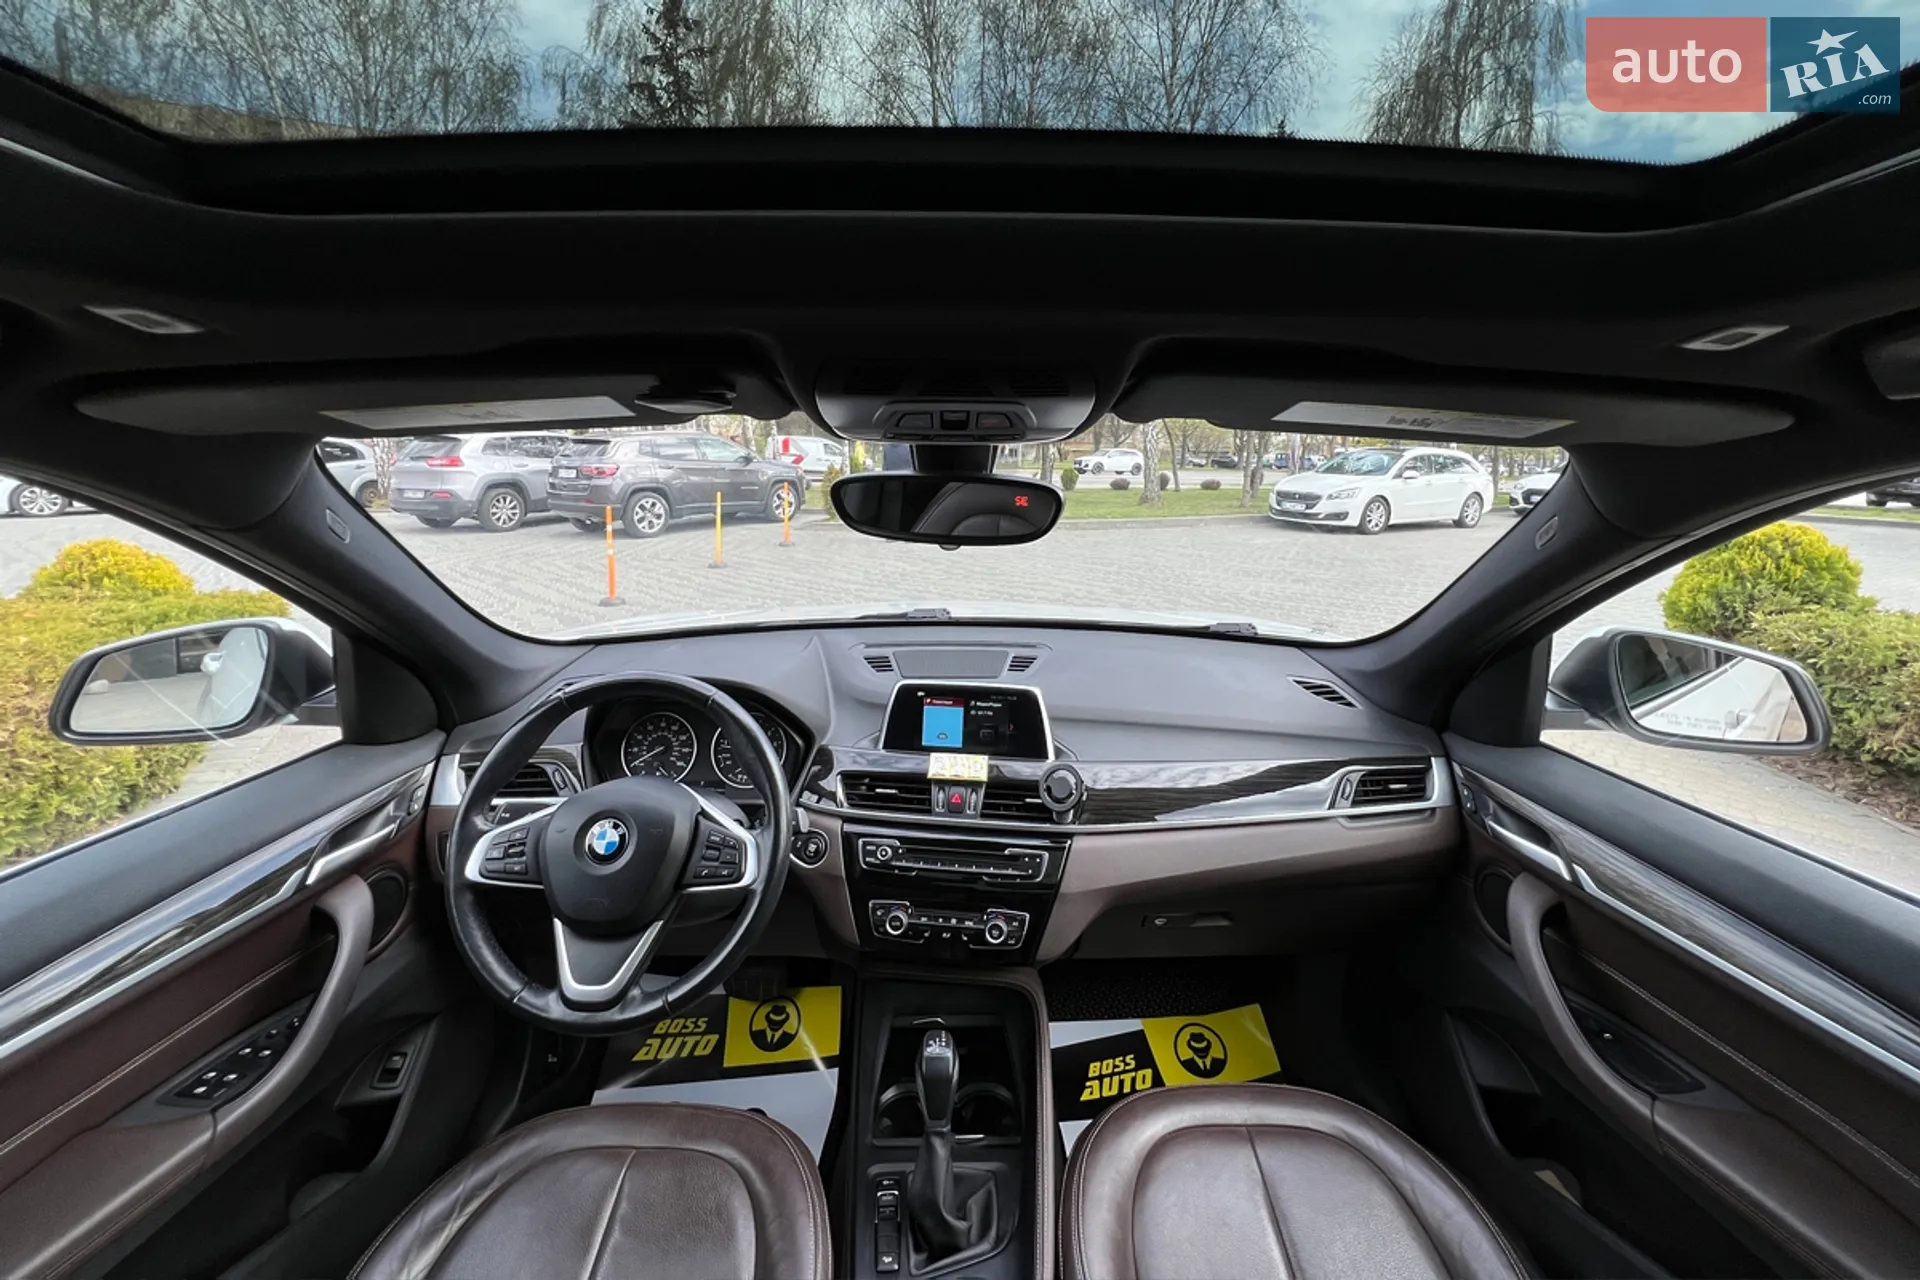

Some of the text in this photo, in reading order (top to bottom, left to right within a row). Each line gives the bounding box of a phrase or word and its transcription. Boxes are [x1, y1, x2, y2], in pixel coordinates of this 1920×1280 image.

[652, 1017, 709, 1035] BOSS
[631, 1033, 719, 1062] AUTO
[1088, 1054, 1136, 1078] BOSS
[1079, 1068, 1153, 1101] AUTO
